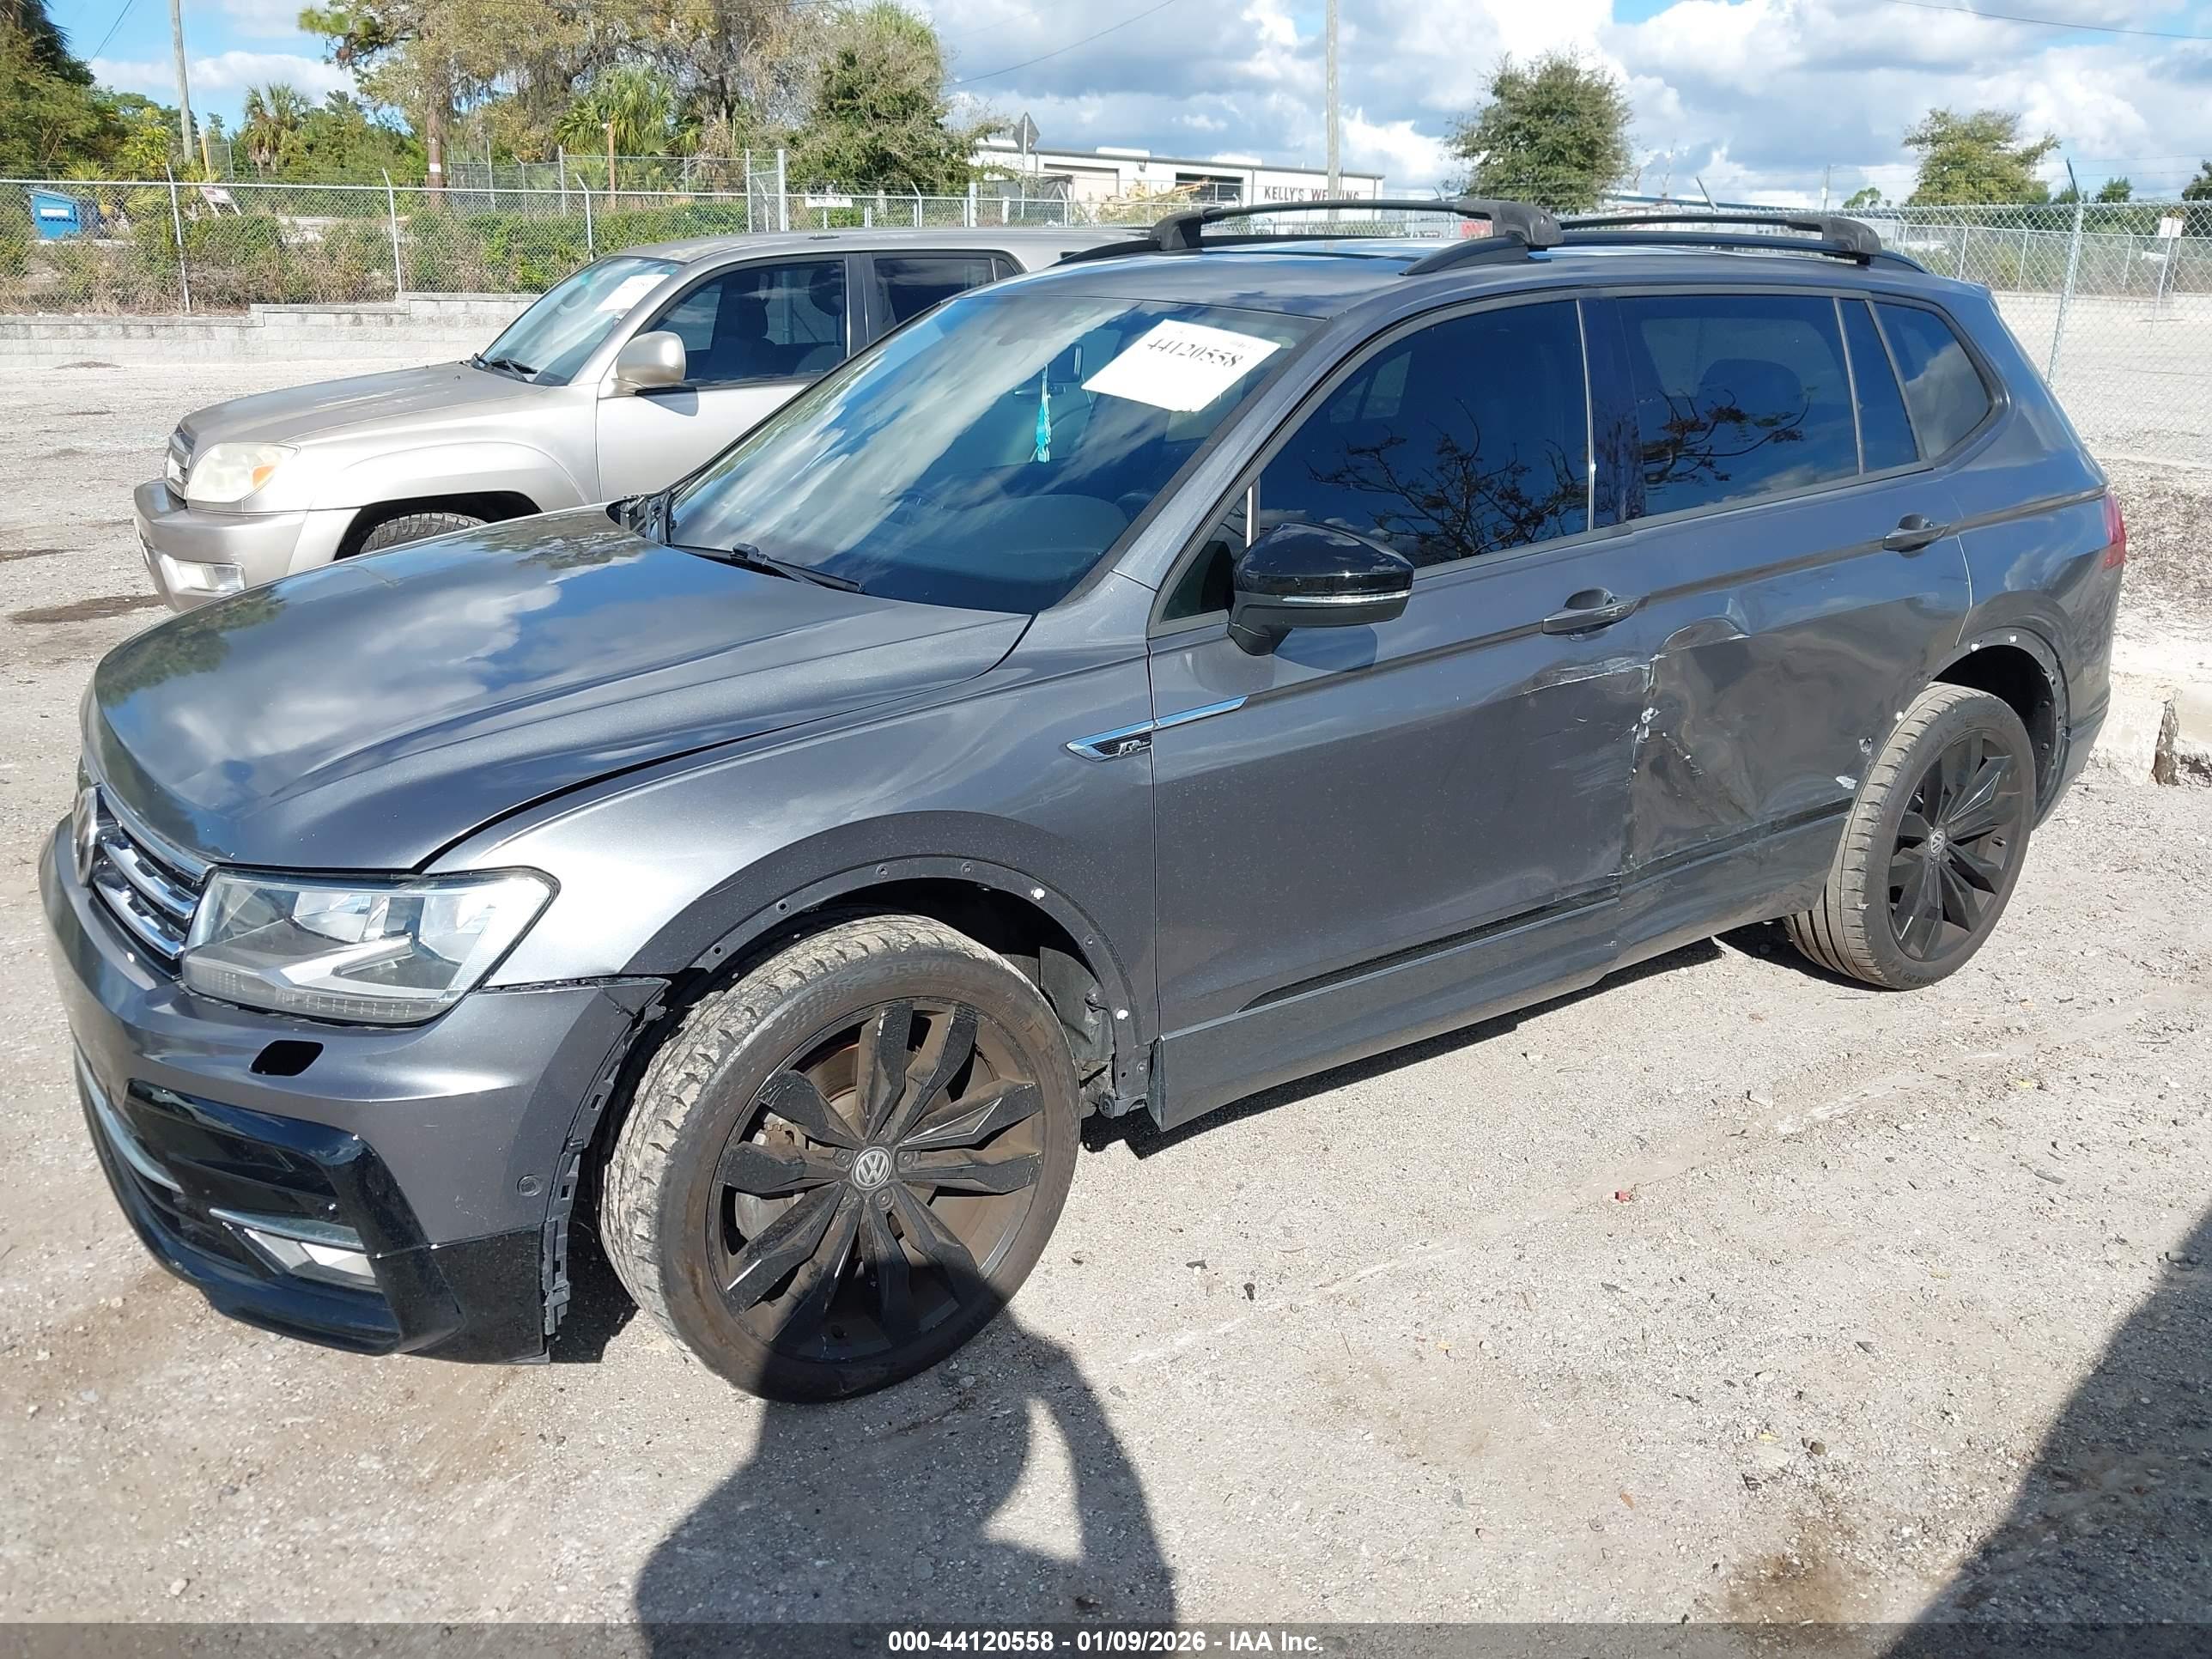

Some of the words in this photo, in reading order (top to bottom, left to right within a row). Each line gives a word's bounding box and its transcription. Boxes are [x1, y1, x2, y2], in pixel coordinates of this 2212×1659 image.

[1264, 185, 1304, 201] KELLY'S
[1147, 338, 1244, 368] 44120558
[854, 1149, 891, 1188] VW
